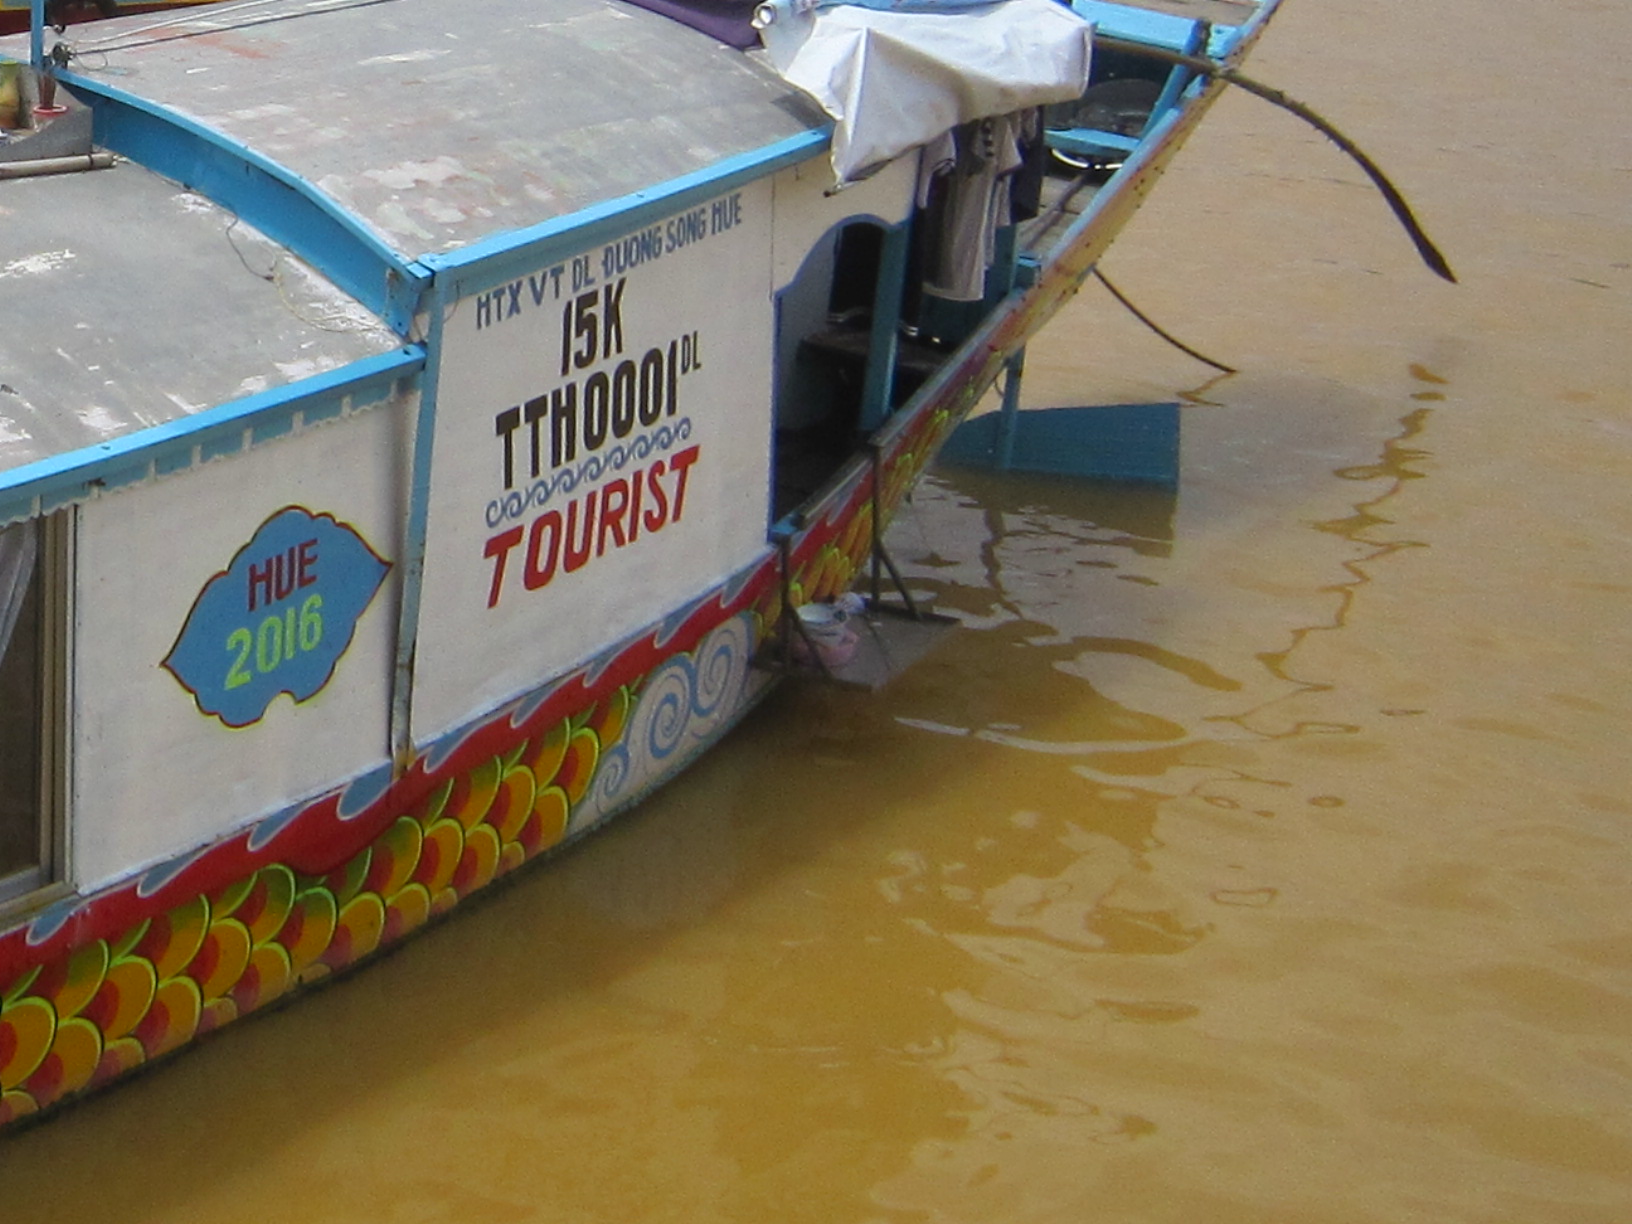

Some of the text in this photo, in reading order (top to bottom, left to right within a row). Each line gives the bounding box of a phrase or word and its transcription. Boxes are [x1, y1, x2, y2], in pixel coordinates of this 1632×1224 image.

[476, 277, 523, 330] HTX
[529, 264, 565, 307] VT
[572, 255, 595, 293] DL
[665, 208, 706, 254] SONG
[711, 193, 742, 235] HUE
[561, 278, 627, 376] 15K
[681, 330, 701, 375] DL
[248, 538, 318, 612] HUE
[483, 445, 700, 609] TOURIST
[225, 594, 323, 691] 2016
